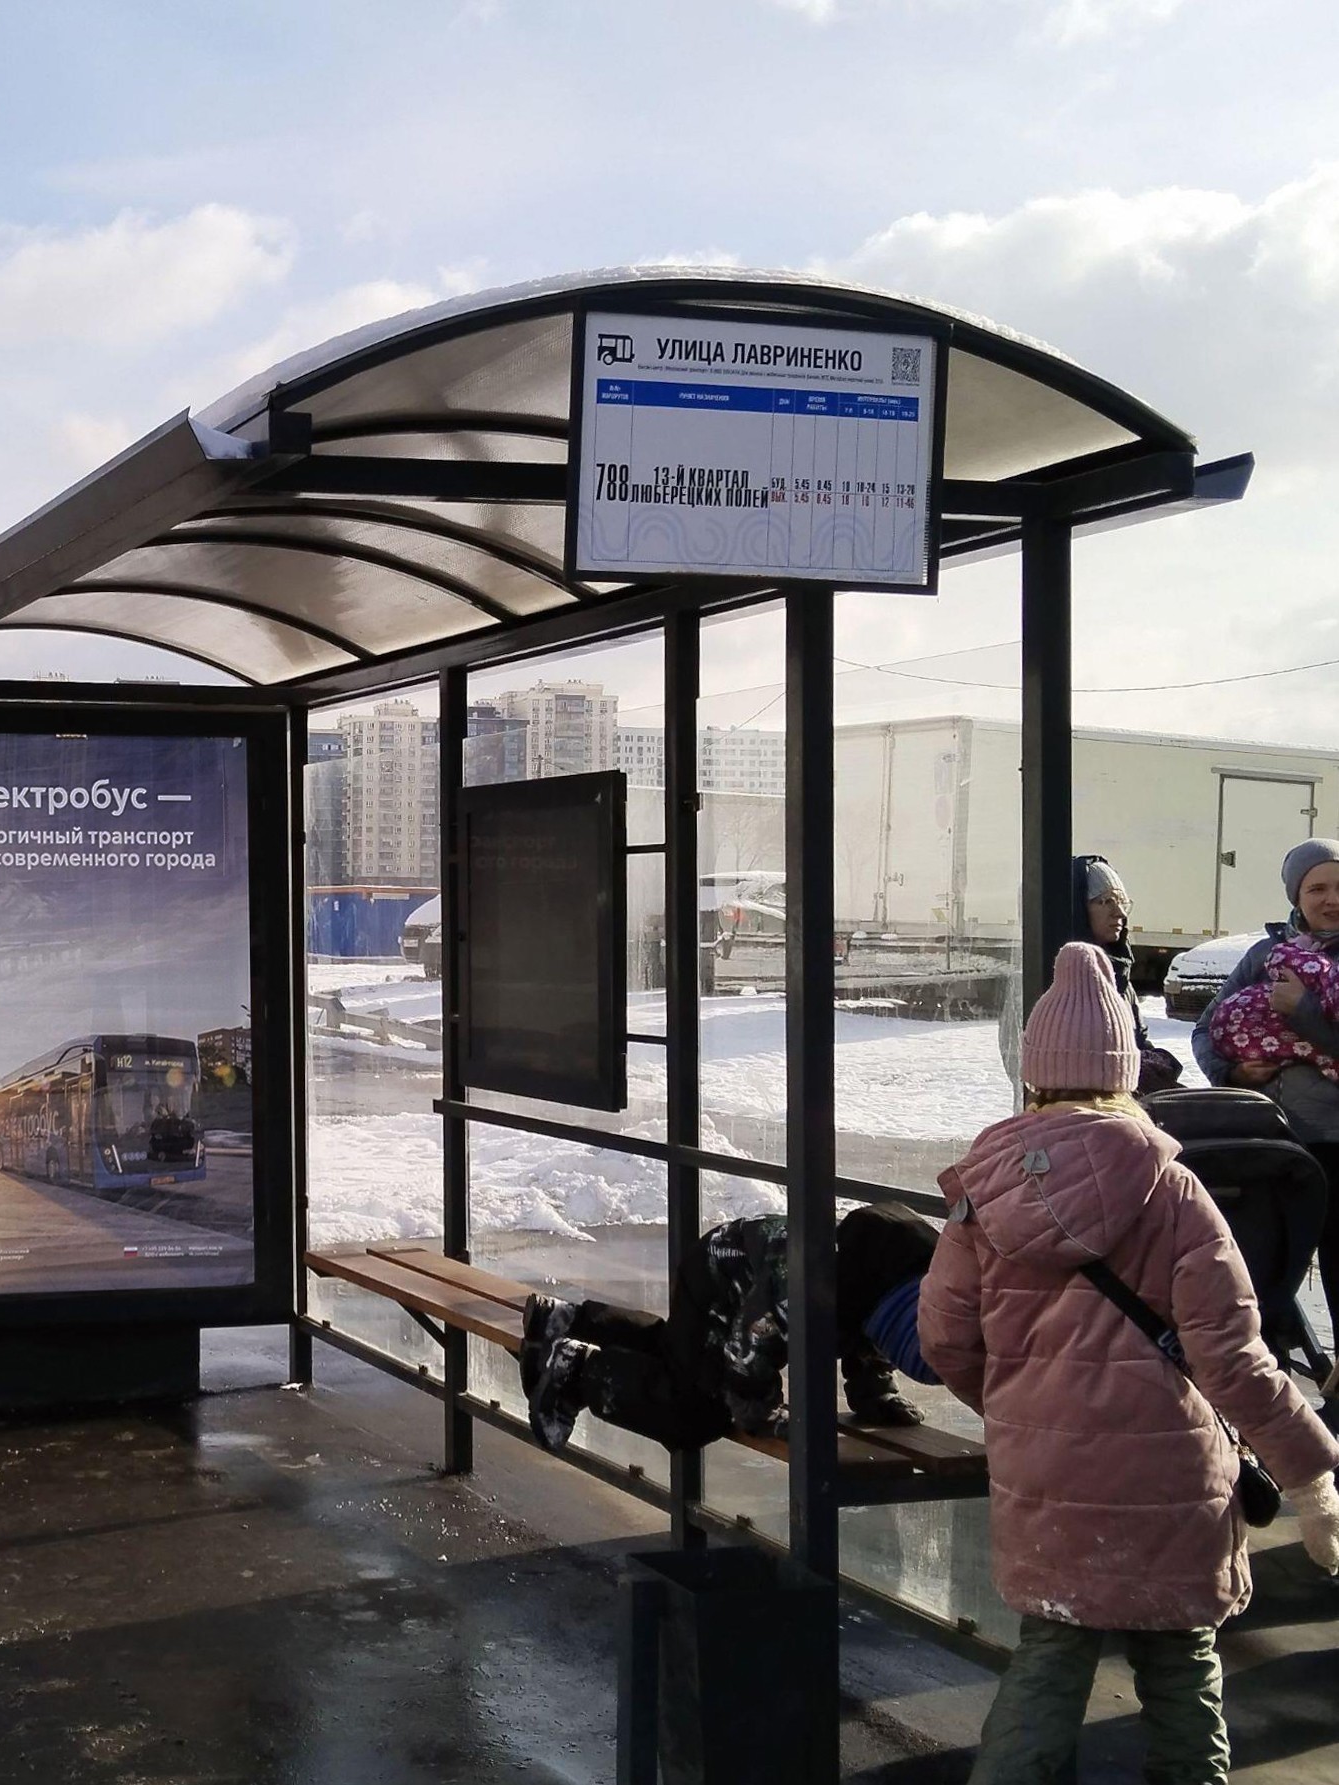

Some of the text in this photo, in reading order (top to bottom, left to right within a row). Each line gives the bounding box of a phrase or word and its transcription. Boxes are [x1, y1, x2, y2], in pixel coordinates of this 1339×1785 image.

[656, 338, 862, 371] УЛИЦА ЛАВРИНЕНКО
[596, 463, 629, 501] 788
[653, 464, 749, 489] 13-Й КВАРТАЛ
[630, 484, 769, 509] ЛЮБЕРЕЦКИХ ПОЛЕЙ
[87, 830, 194, 848] транспорт
[145, 854, 216, 870] города
